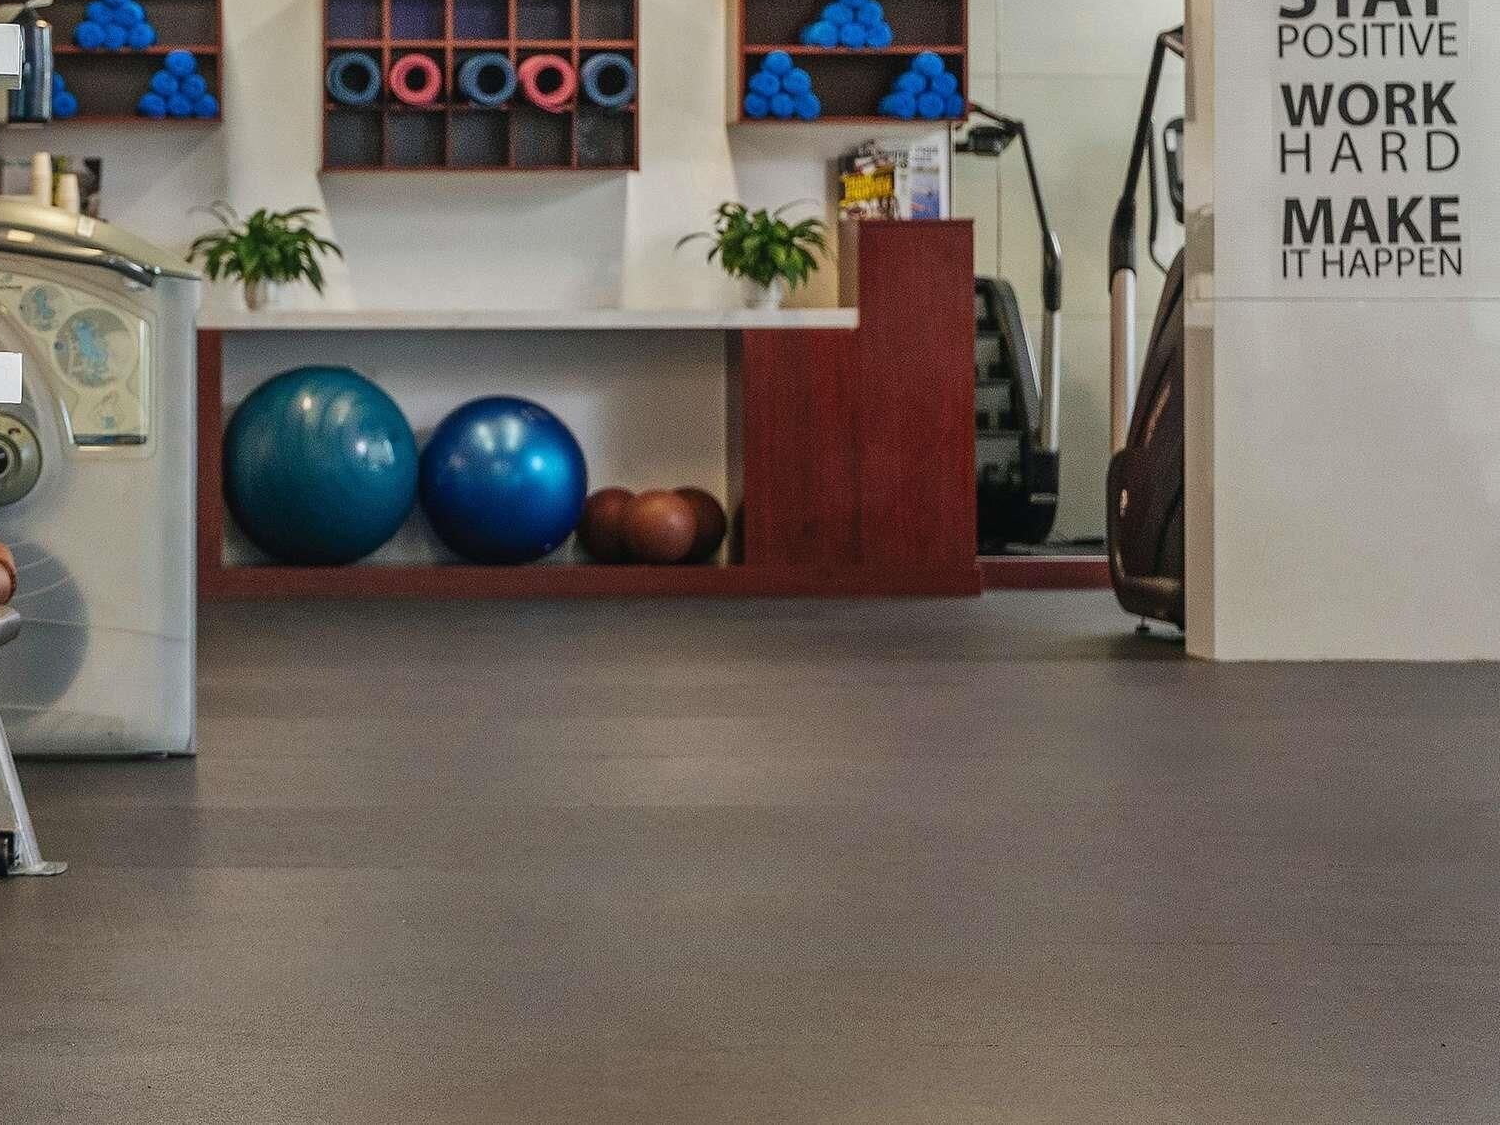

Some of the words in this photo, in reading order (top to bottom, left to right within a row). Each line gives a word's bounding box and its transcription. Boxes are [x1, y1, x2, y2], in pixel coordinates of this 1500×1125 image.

[1277, 22, 1458, 58] POSITIVE
[1280, 81, 1458, 127] WORK
[1279, 131, 1460, 174] HARD
[1282, 196, 1461, 245] MAKE
[1281, 248, 1311, 279] IT
[1321, 246, 1463, 279] HAPPEN
